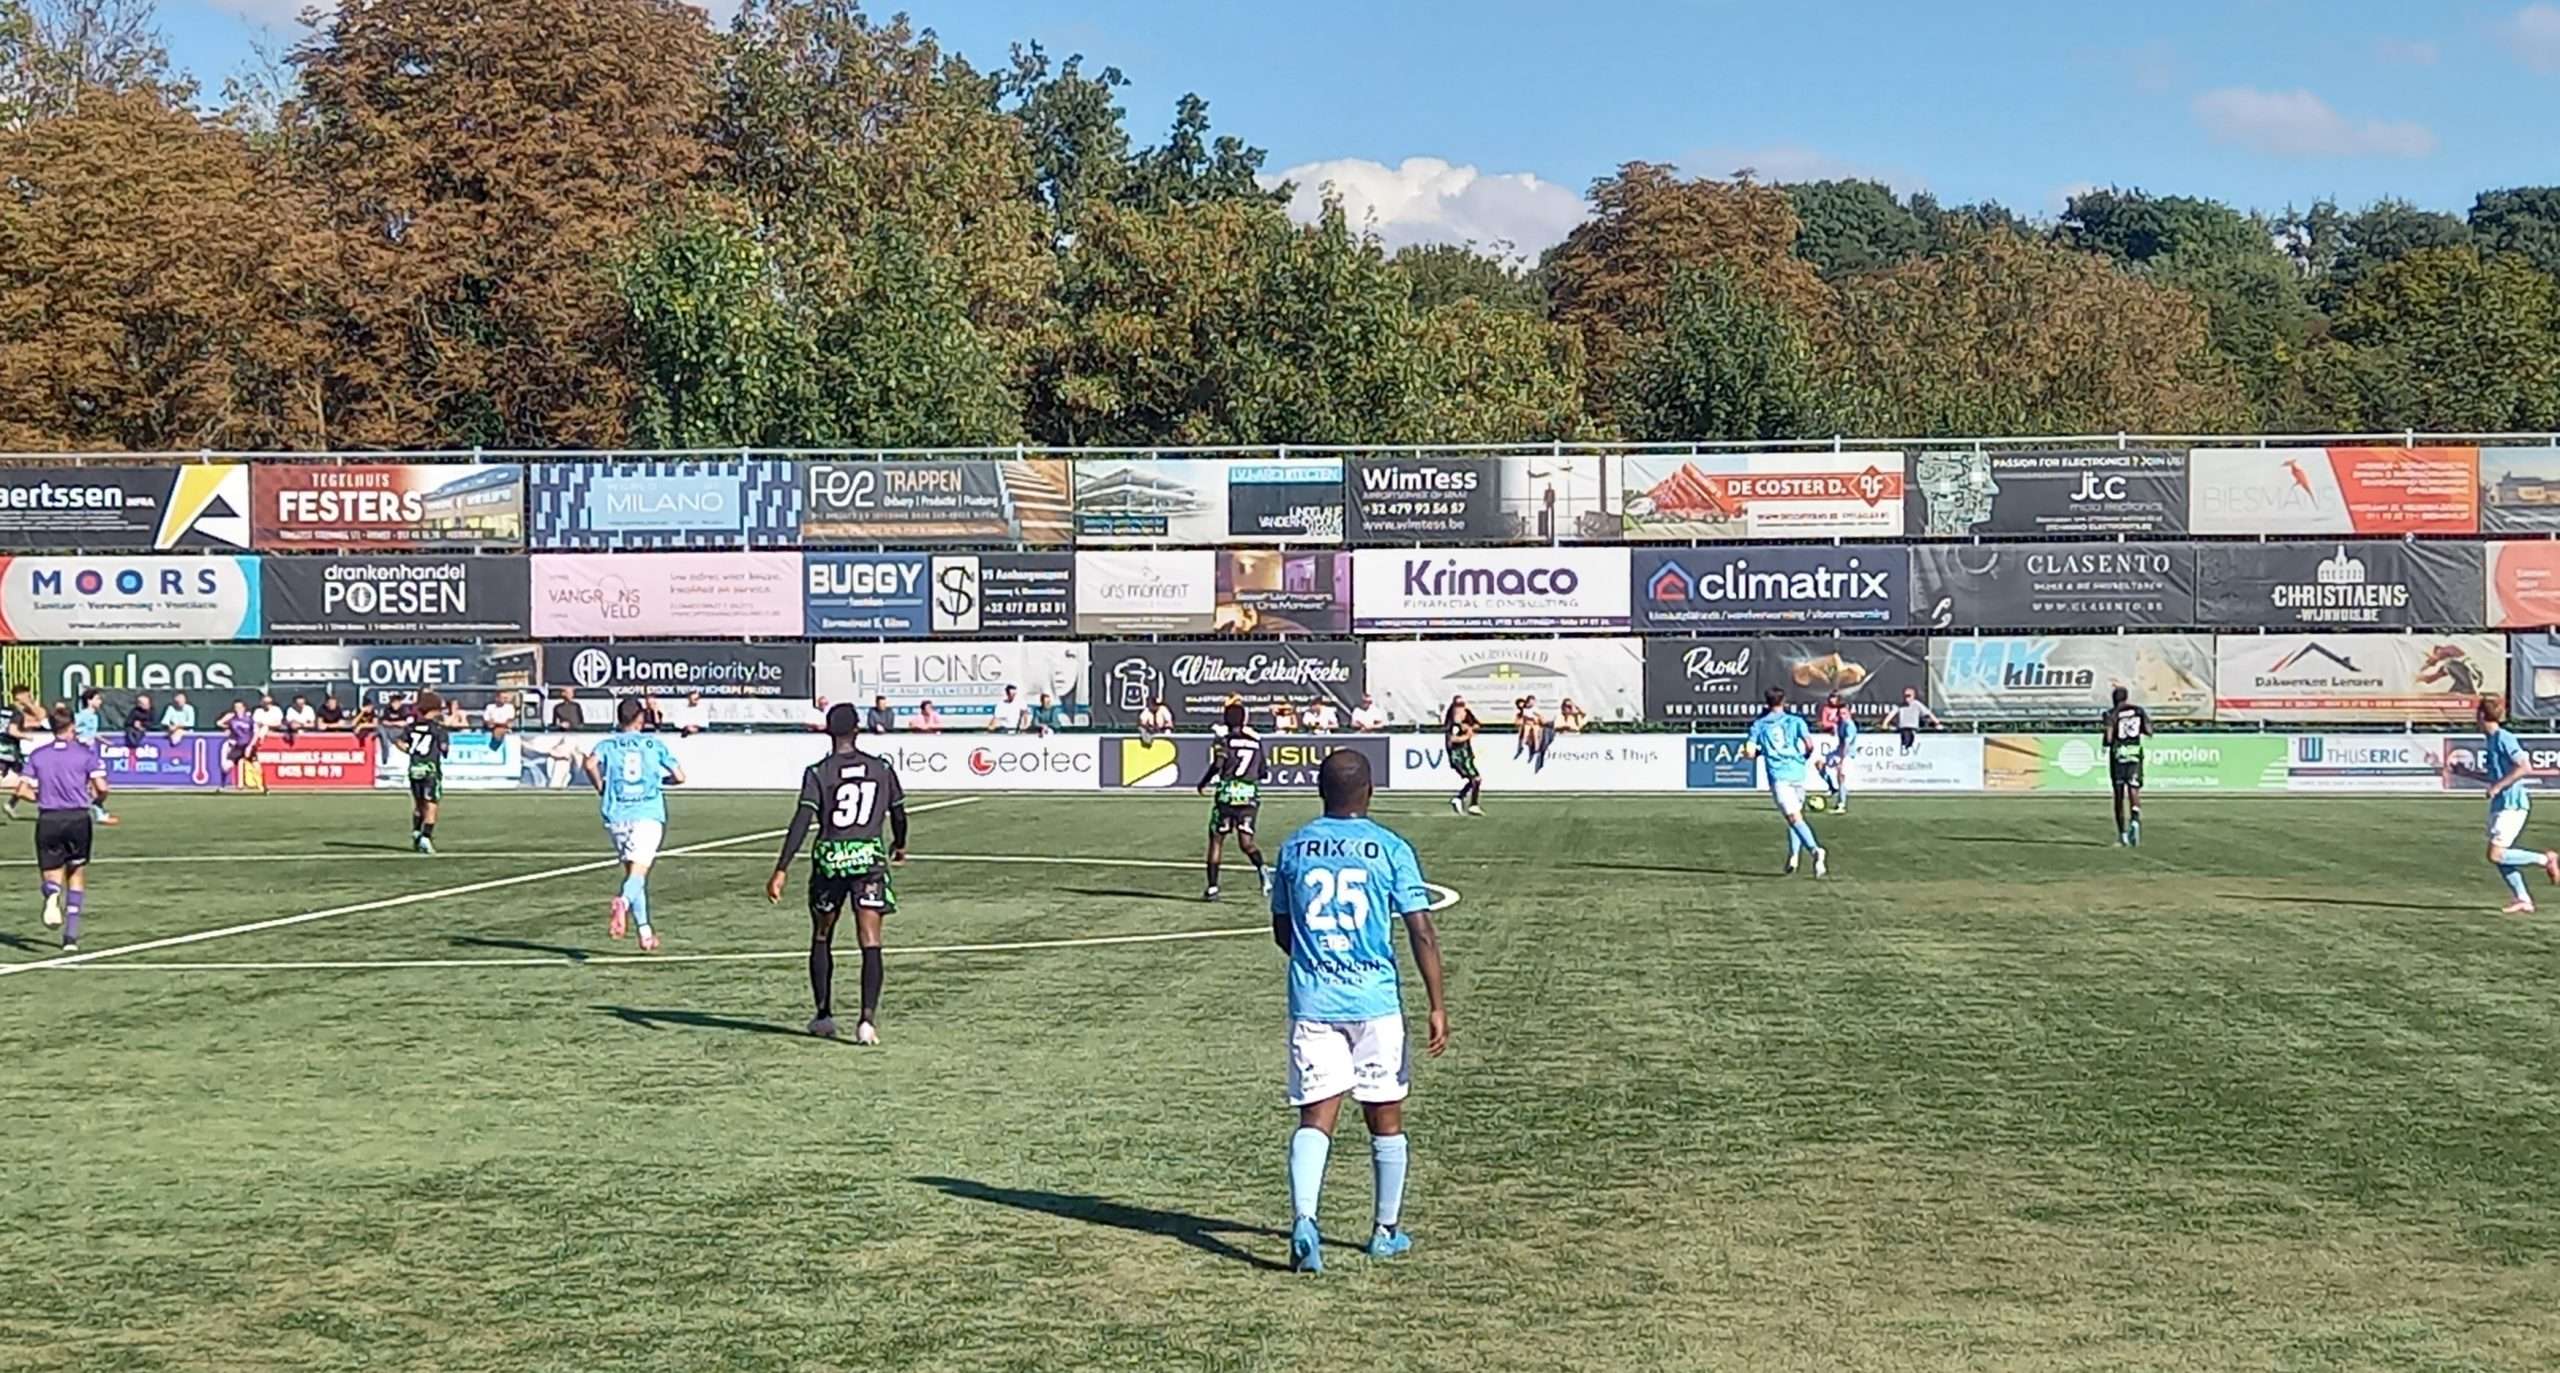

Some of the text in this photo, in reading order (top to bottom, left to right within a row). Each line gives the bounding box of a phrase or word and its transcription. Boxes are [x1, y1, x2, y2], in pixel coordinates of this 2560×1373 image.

[1993, 458, 2038, 469] PASSION
[2039, 458, 2060, 468] FOR
[2141, 456, 2165, 467] JOIN
[884, 469, 962, 492] TRAPPEN
[1362, 467, 1478, 490] WimTess
[1728, 478, 1847, 497] DE COSTER D.
[279, 490, 424, 522] FESTERS
[606, 492, 723, 514] MILANO
[1363, 517, 1465, 531] www.wimtess.be
[324, 564, 466, 581] drankenhandel
[2027, 554, 2171, 574] CLASENTO
[32, 569, 218, 596] MOORS
[809, 564, 923, 594] BUGGY
[1403, 558, 1579, 596] Krimaco
[1699, 558, 1889, 600] climatrix
[324, 581, 467, 613] POESEN
[1127, 582, 1190, 599] moment
[1402, 597, 1581, 609] FINANCIAL CONSULTING
[2271, 585, 2409, 608] CHRISTIAENS
[602, 604, 640, 618] VELD
[352, 658, 462, 684] LOWET
[615, 655, 783, 682] Homepriority.be
[914, 653, 1002, 683] ICING
[1682, 646, 1751, 679] Raoul
[2003, 662, 2094, 687] klima
[967, 747, 1092, 776] Geotec
[1234, 749, 1255, 777] 7
[2532, 751, 2560, 768] SP
[832, 782, 878, 828] 31
[1303, 867, 1369, 932] 25
